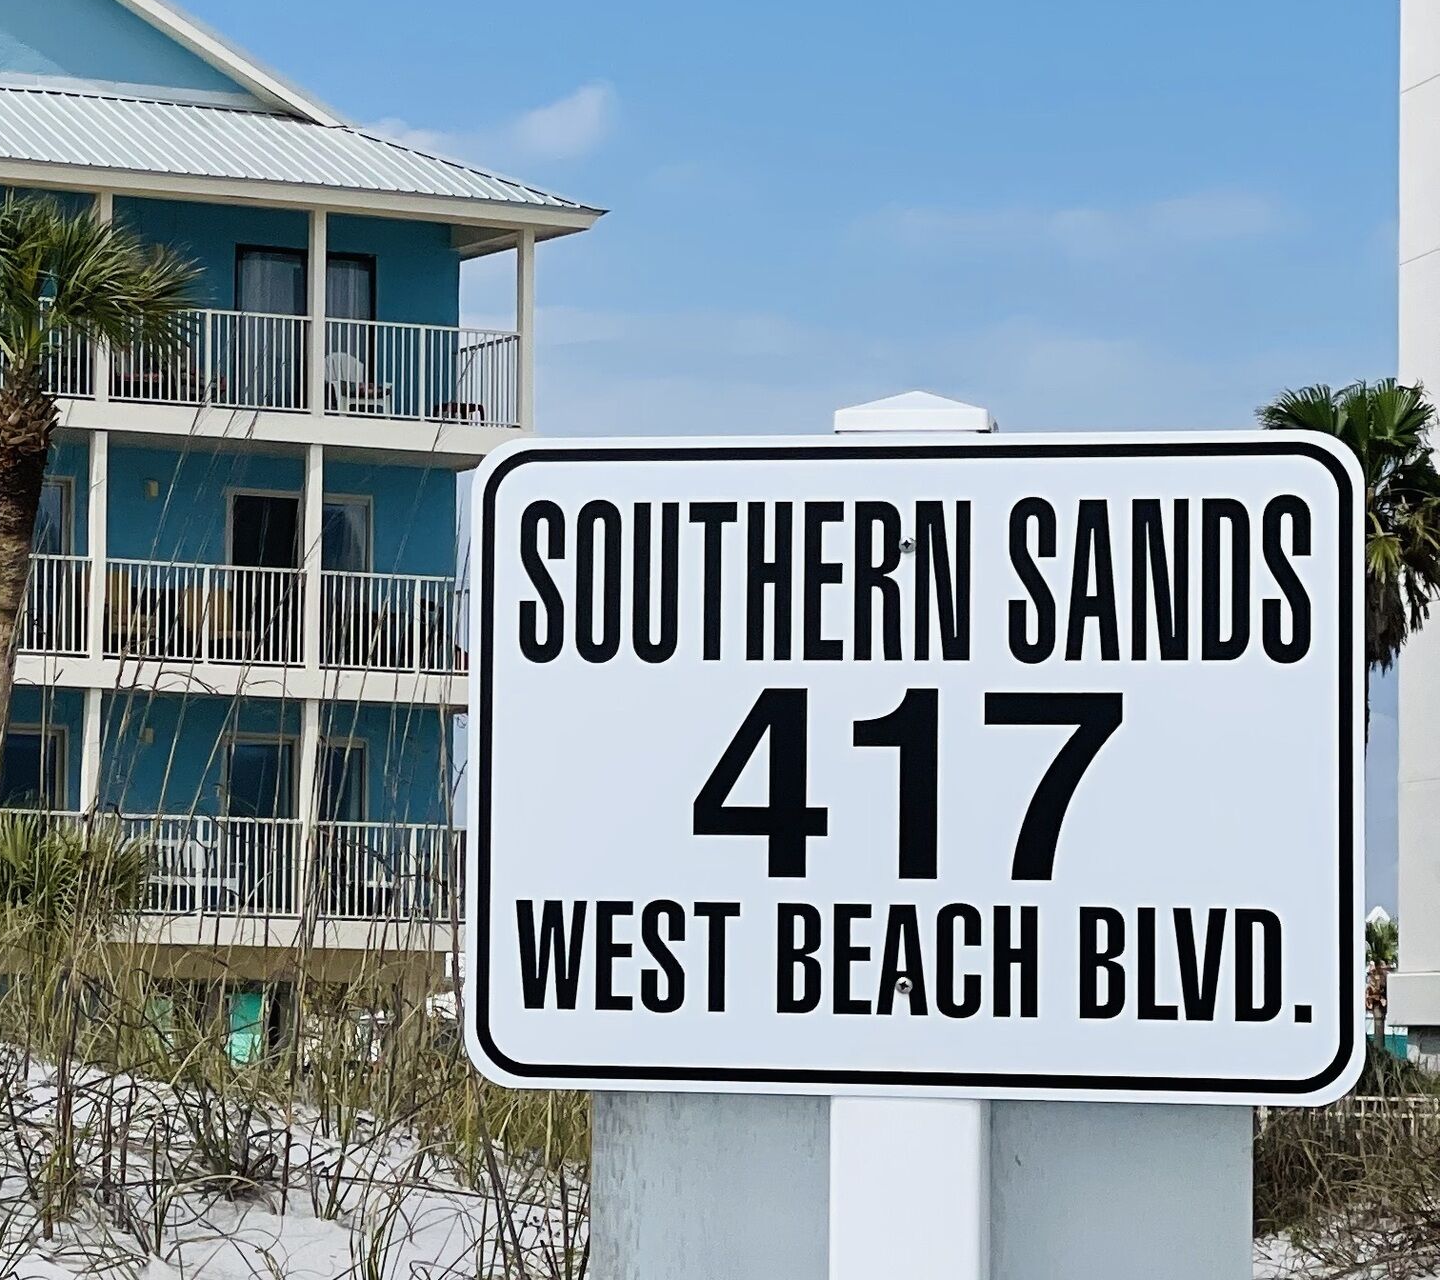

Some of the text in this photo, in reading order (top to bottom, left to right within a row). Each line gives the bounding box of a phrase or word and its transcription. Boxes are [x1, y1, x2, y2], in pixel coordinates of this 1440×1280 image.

[518, 494, 1313, 665] SOUTHERN SANDS
[691, 686, 1124, 881] 417
[515, 899, 1313, 1025] WEST BEACH BLVD.
